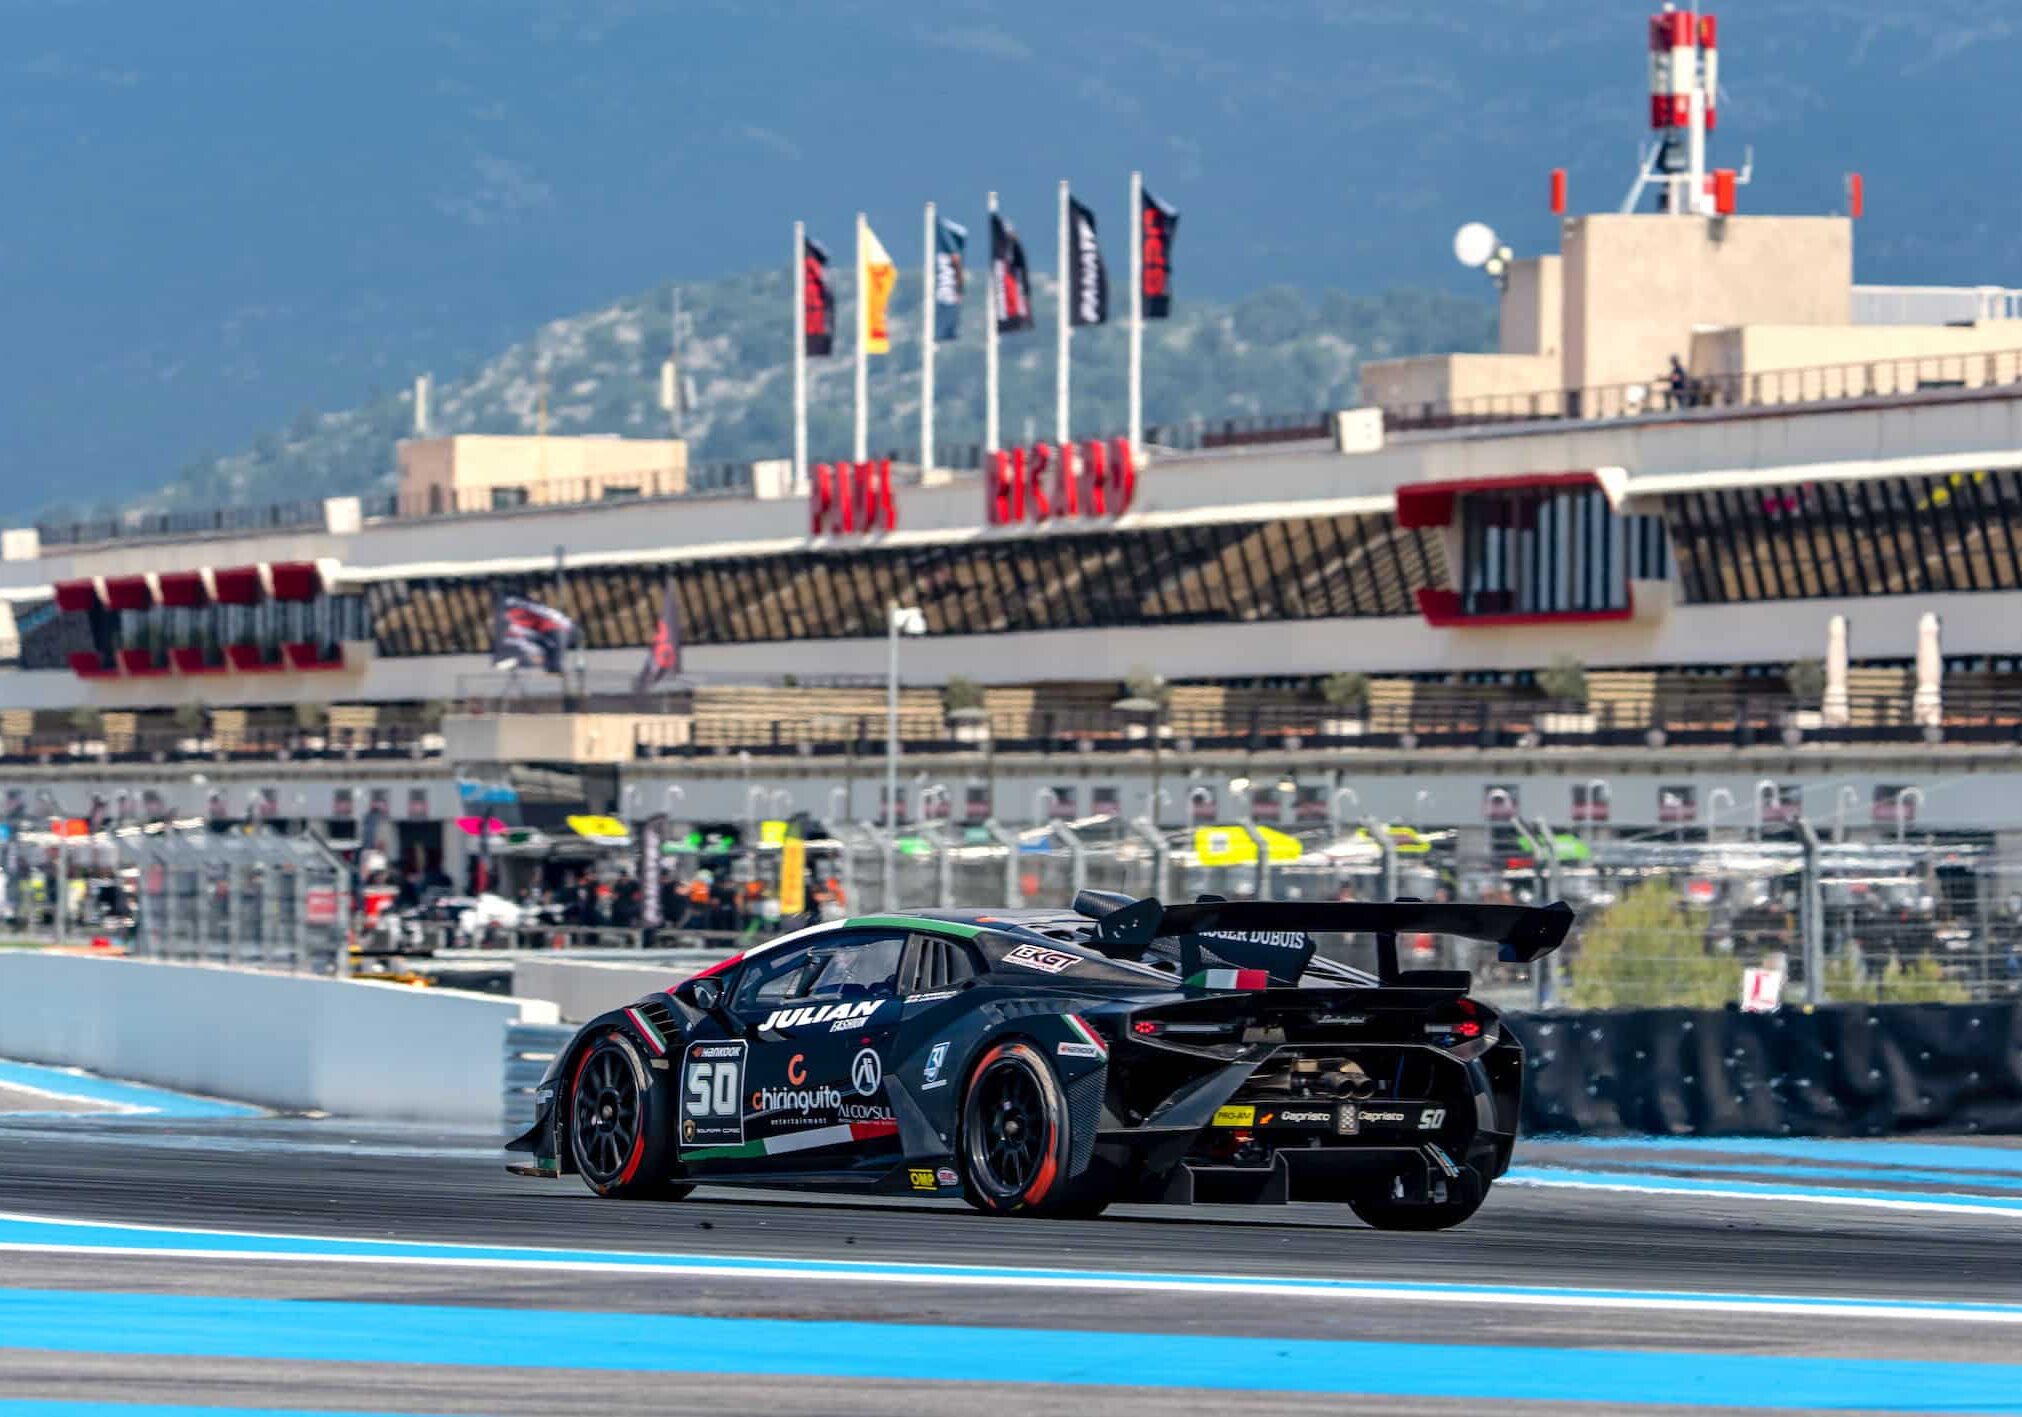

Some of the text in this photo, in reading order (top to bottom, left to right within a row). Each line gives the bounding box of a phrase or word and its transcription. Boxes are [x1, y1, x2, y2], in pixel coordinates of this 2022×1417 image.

[1249, 931, 1305, 950] DUBUIS
[757, 999, 886, 1031] JULIAN
[686, 1063, 738, 1116] 50
[752, 1086, 841, 1115] chiringuito
[1417, 1108, 1447, 1130] 50
[910, 1171, 936, 1187] OMP
